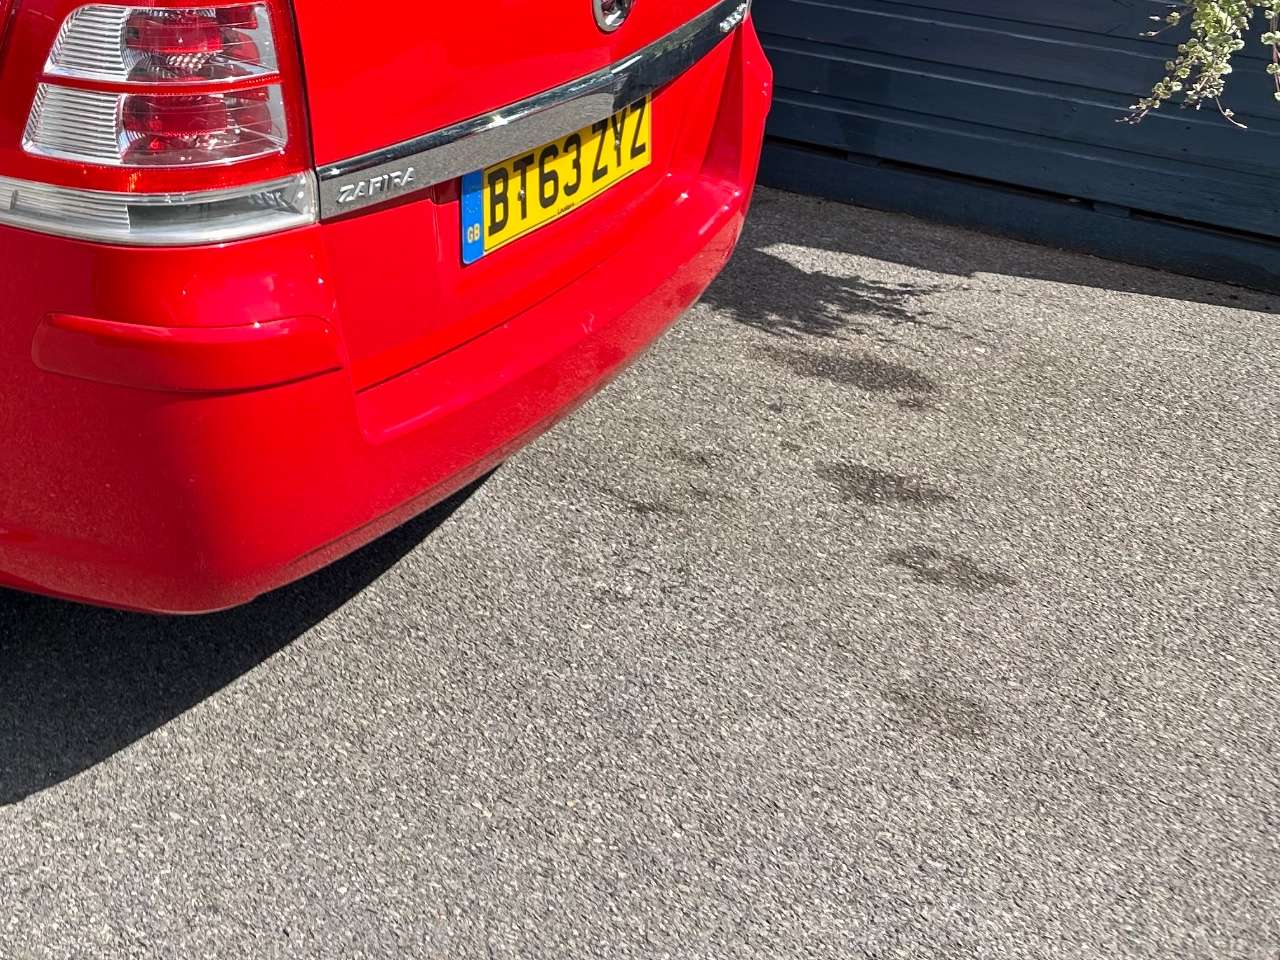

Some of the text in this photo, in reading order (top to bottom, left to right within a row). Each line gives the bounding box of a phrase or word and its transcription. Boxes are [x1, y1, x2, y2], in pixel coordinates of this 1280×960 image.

[335, 166, 416, 204] ZAFIRA
[487, 95, 647, 237] BT63 ZYZ
[467, 223, 480, 244] GB
